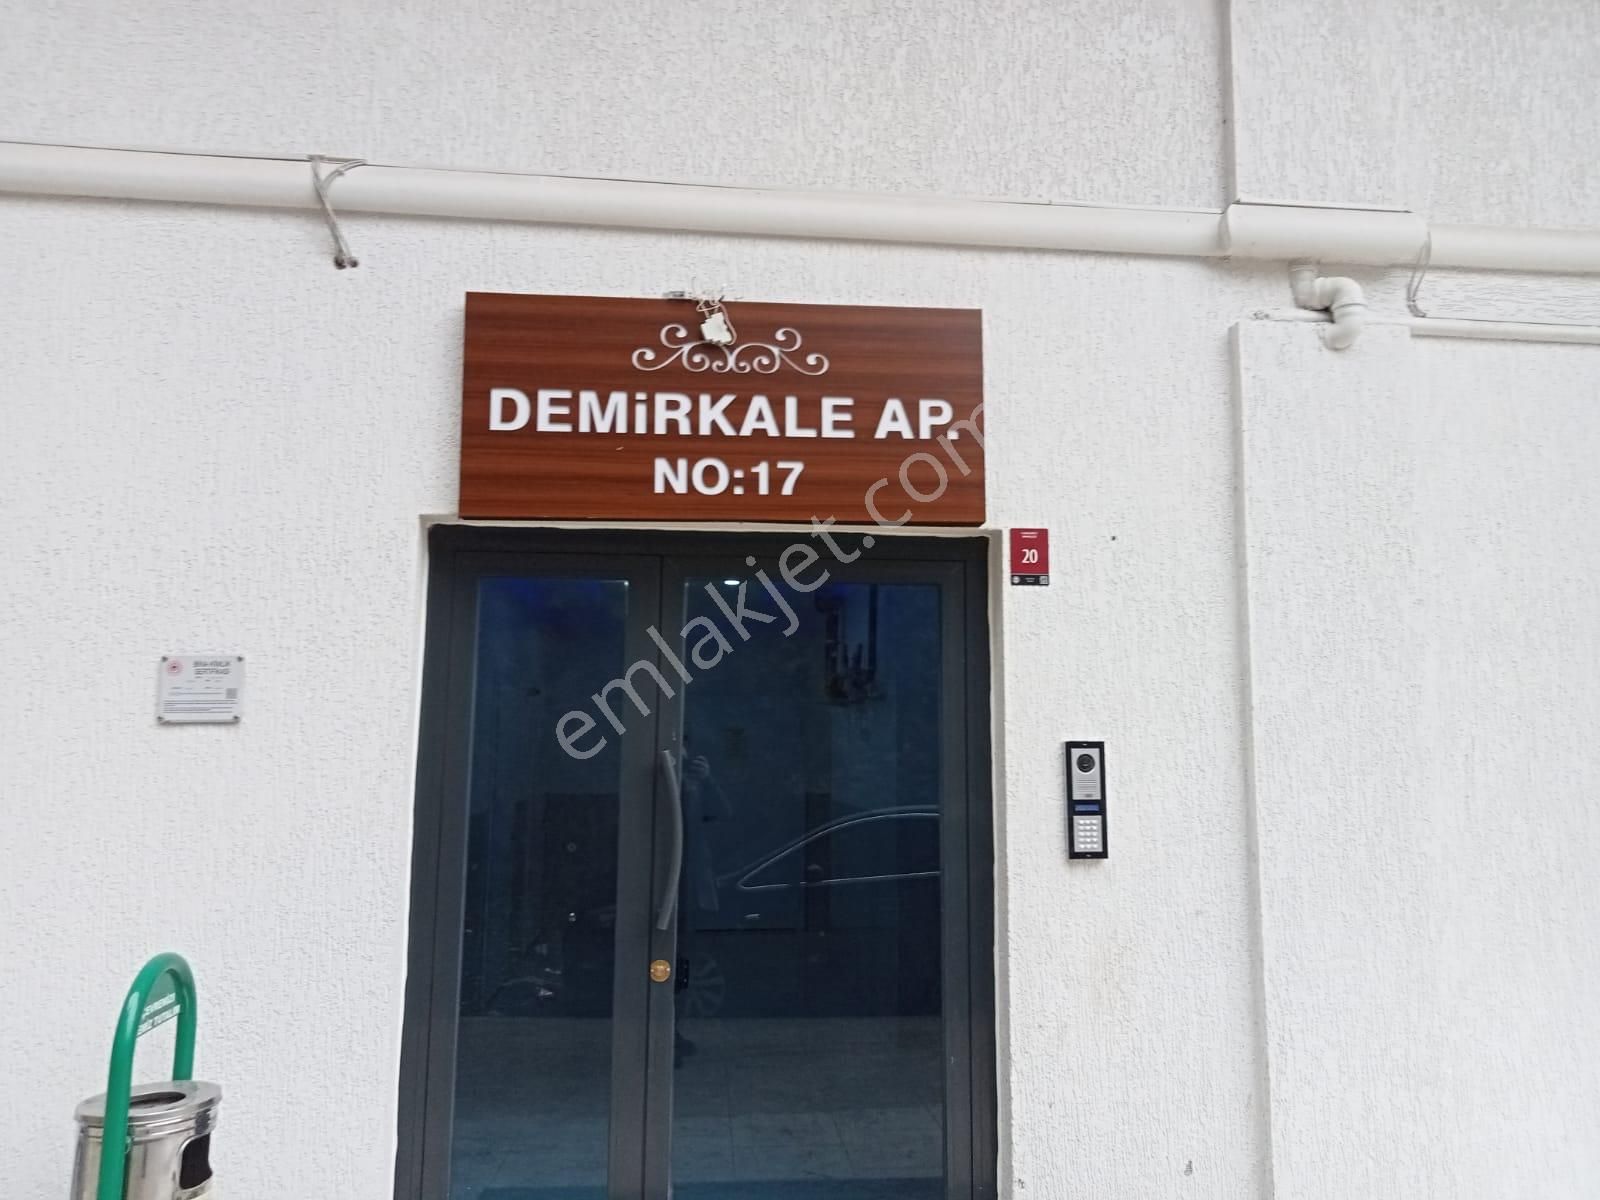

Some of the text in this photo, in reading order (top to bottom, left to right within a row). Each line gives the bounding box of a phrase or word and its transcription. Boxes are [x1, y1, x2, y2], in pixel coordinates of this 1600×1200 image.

[874, 398, 960, 441] AP.
[653, 457, 805, 497] NO:17
[1021, 548, 1039, 564] 20
